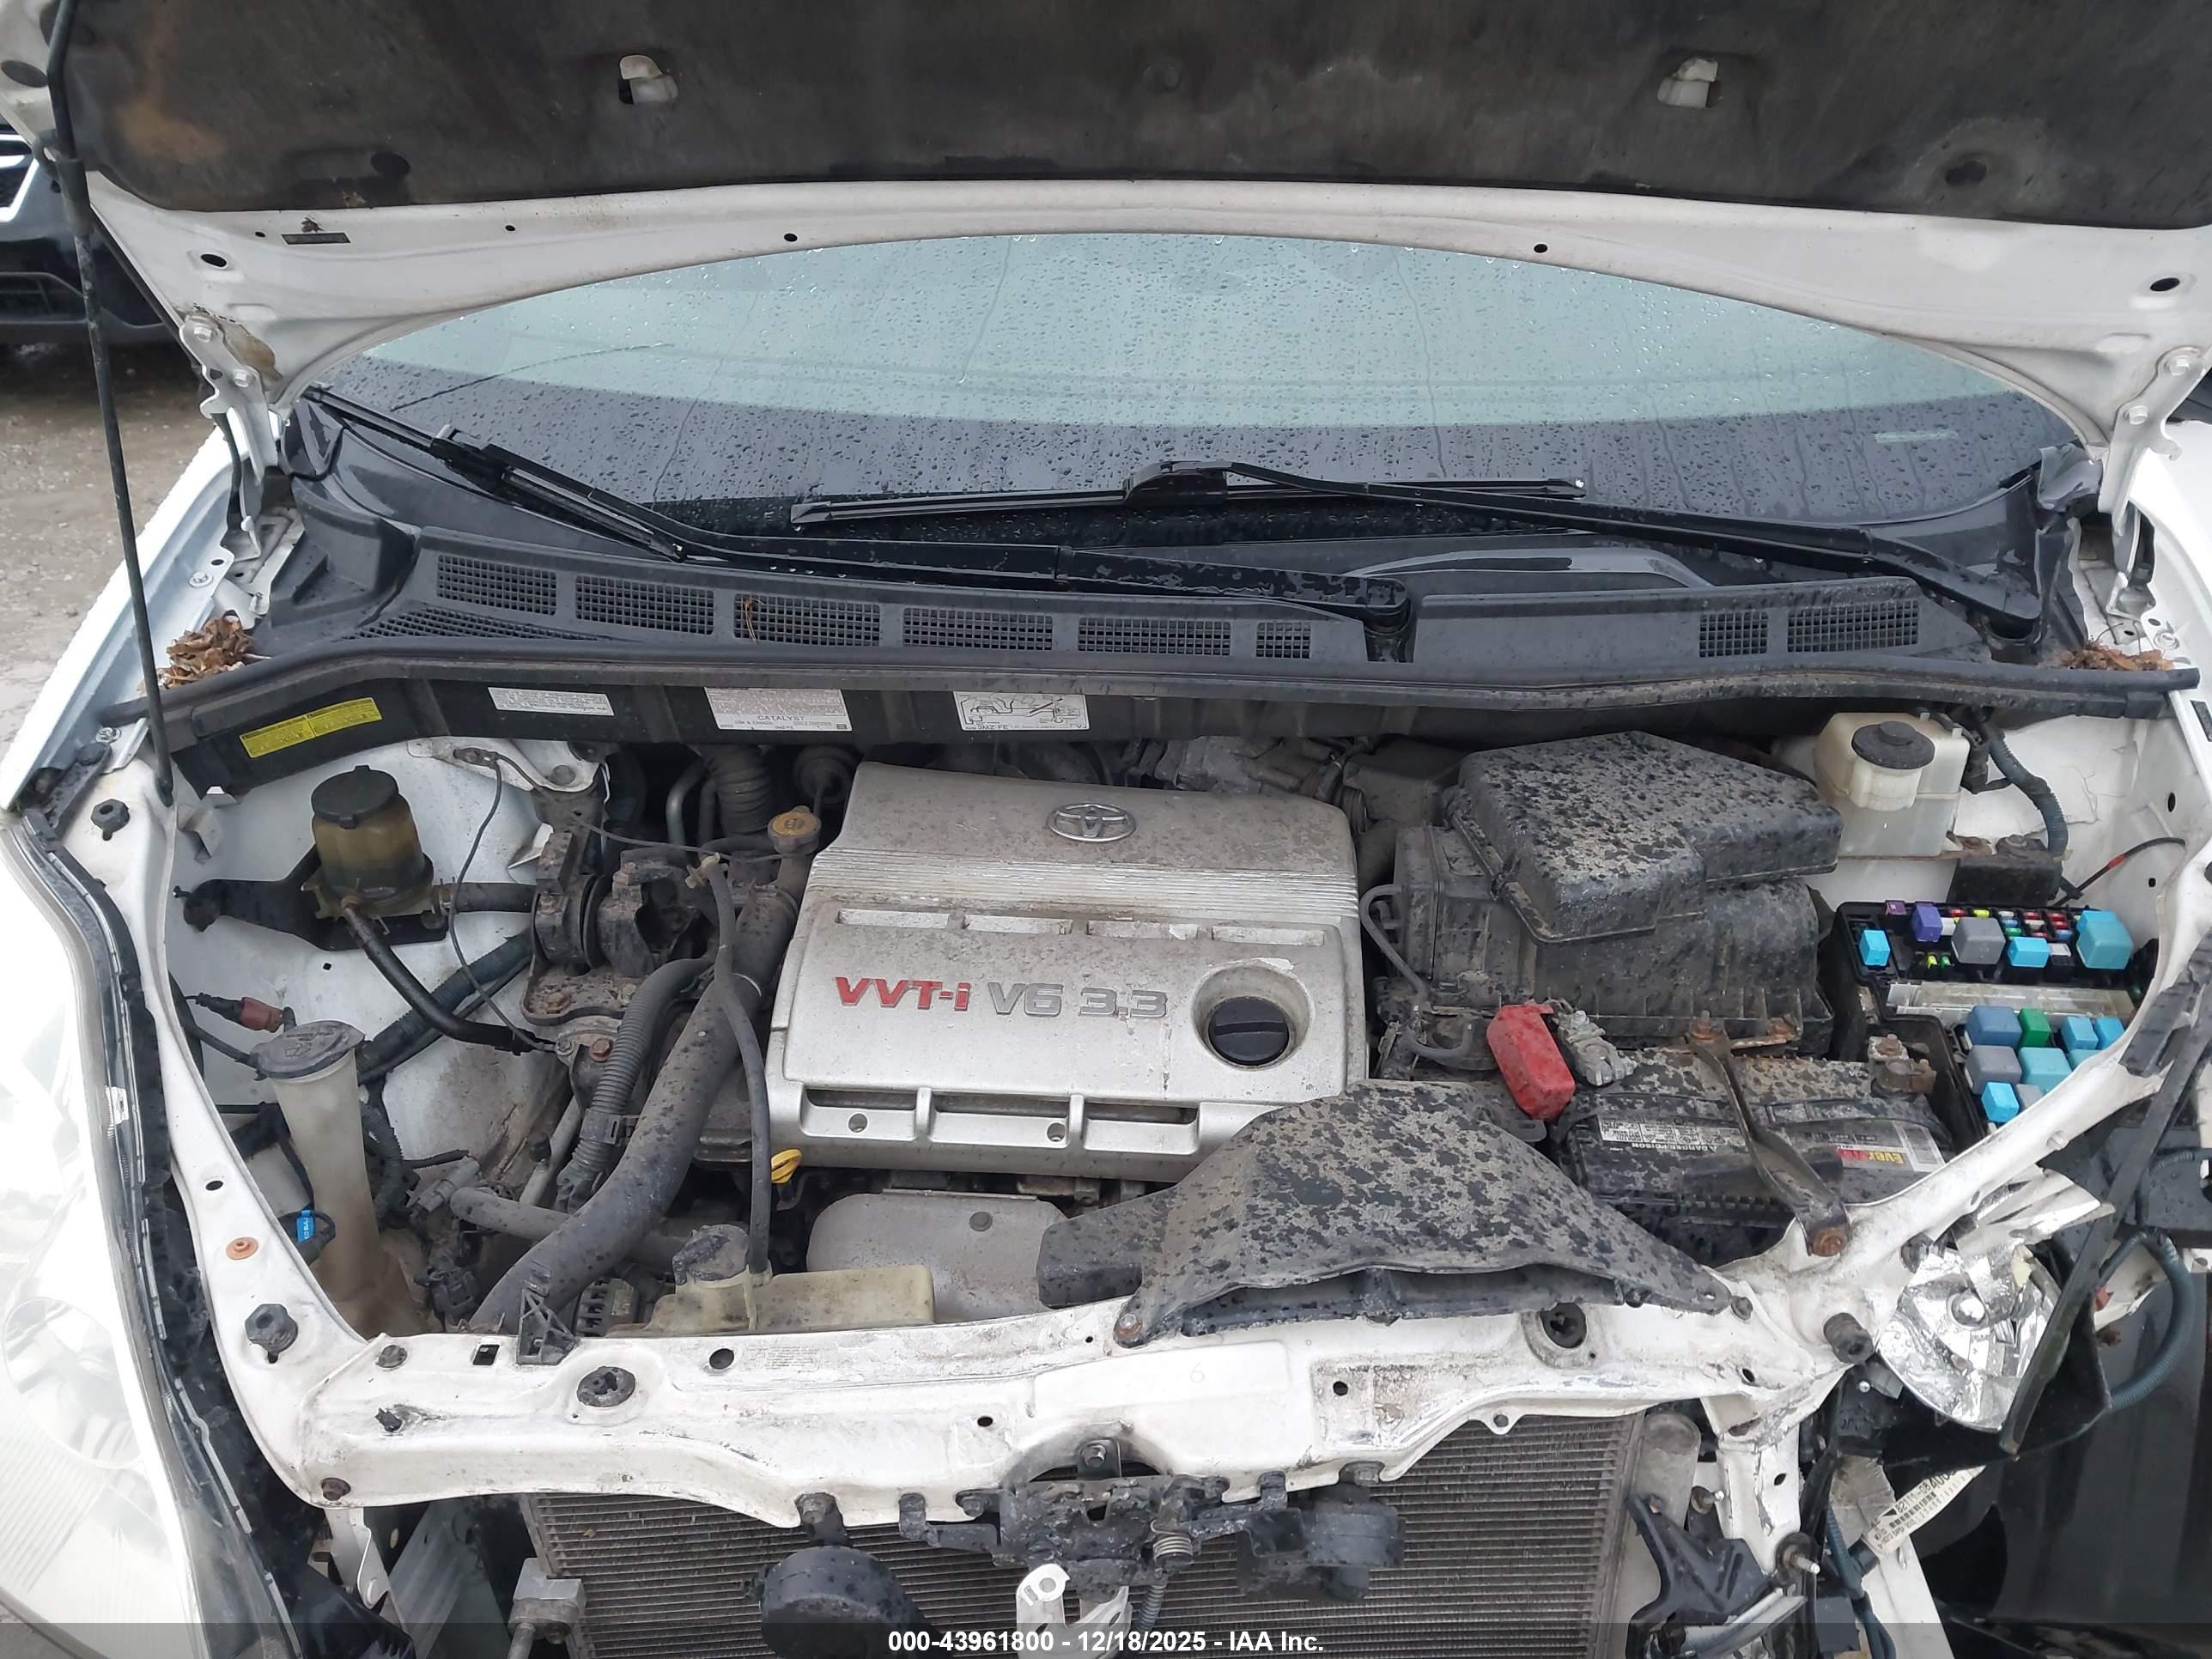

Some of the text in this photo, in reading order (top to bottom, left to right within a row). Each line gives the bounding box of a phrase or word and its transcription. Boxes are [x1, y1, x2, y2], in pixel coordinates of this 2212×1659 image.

[836, 976, 1168, 1019] VVT-i V6 3.3
